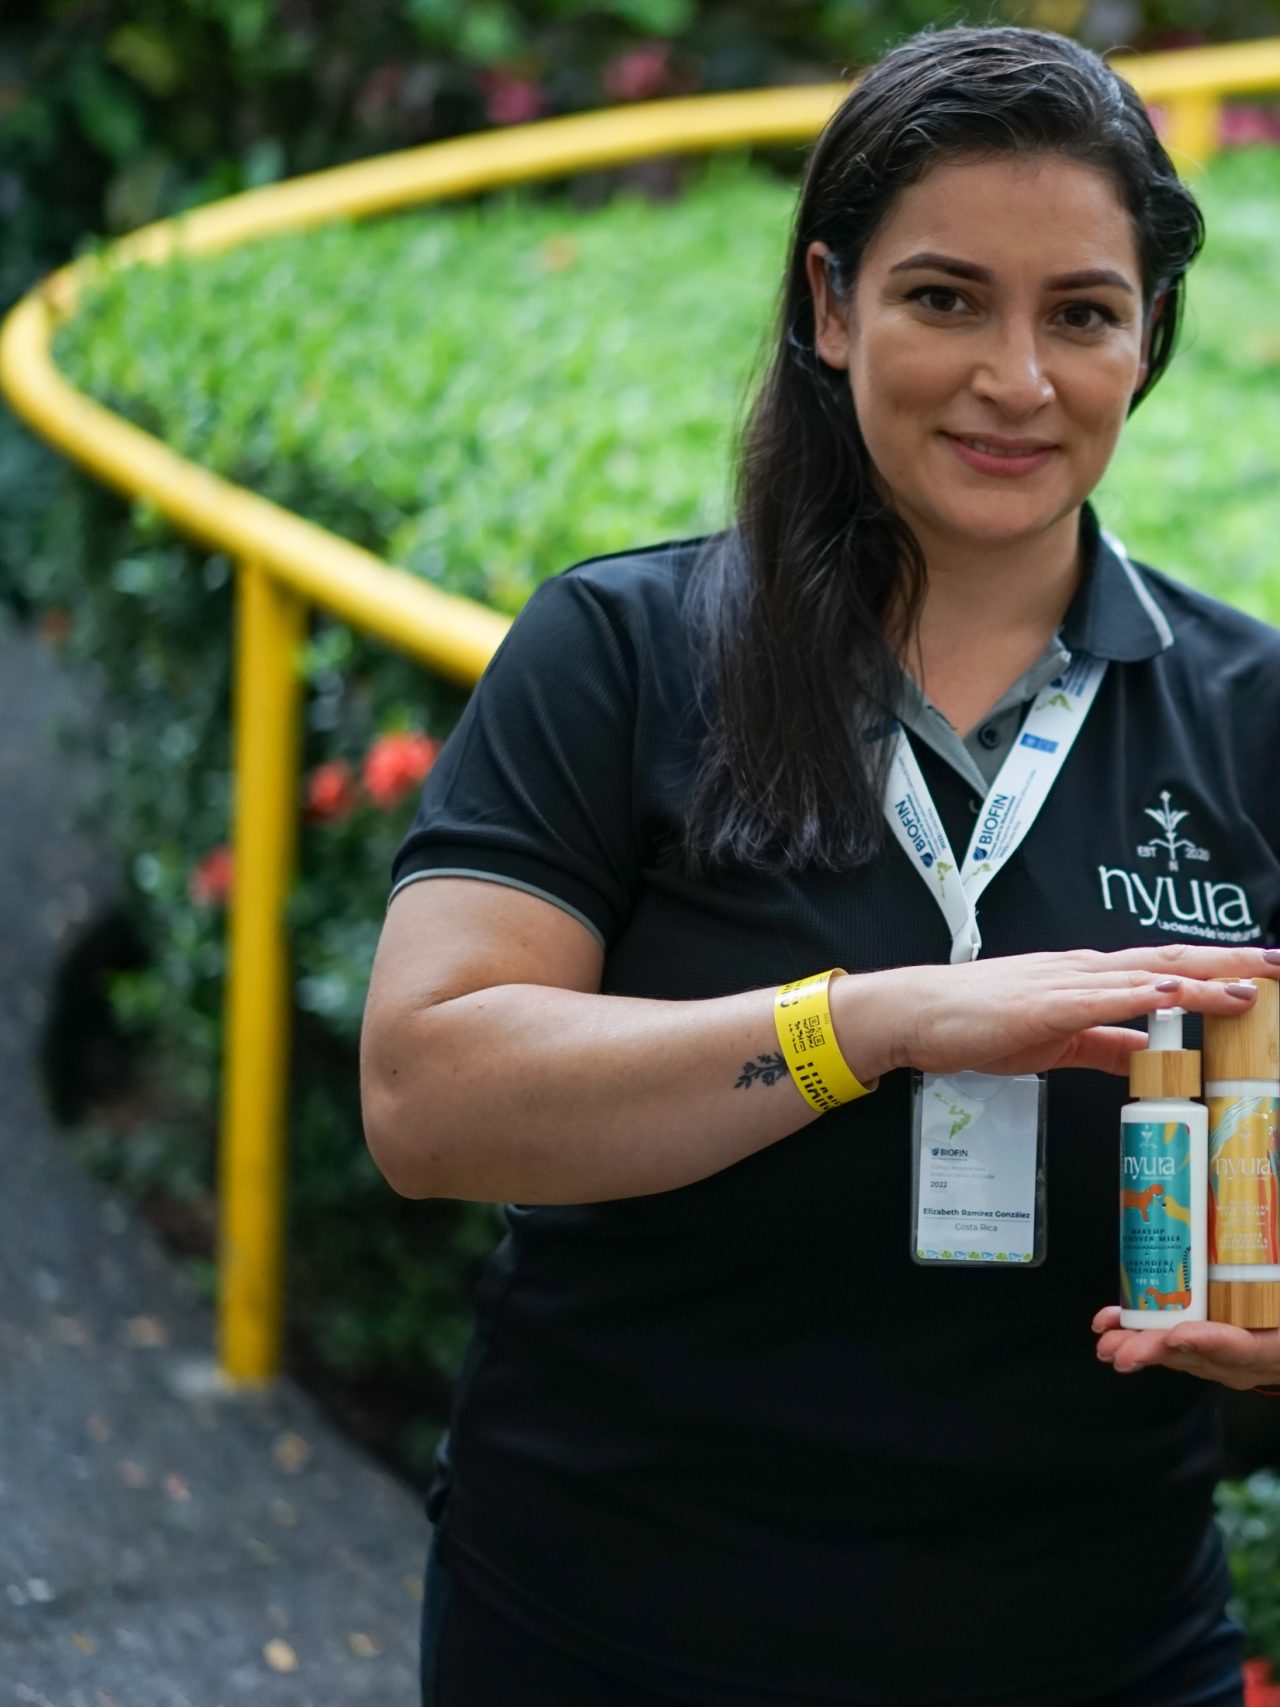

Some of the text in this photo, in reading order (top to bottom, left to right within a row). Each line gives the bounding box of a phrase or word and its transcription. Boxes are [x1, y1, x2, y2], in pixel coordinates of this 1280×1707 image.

[895, 800, 926, 852] BIOFIN
[979, 794, 1008, 845] BIOFIN
[1137, 845, 1157, 858] EST
[1098, 864, 1253, 928] nyura
[940, 1148, 968, 1157] BIOFIN
[1124, 1156, 1175, 1180] nyura
[1216, 1157, 1271, 1180] nyura
[923, 1208, 959, 1216] Elizabeth
[995, 1210, 1031, 1219] González
[954, 1223, 998, 1232] Costa Rica
